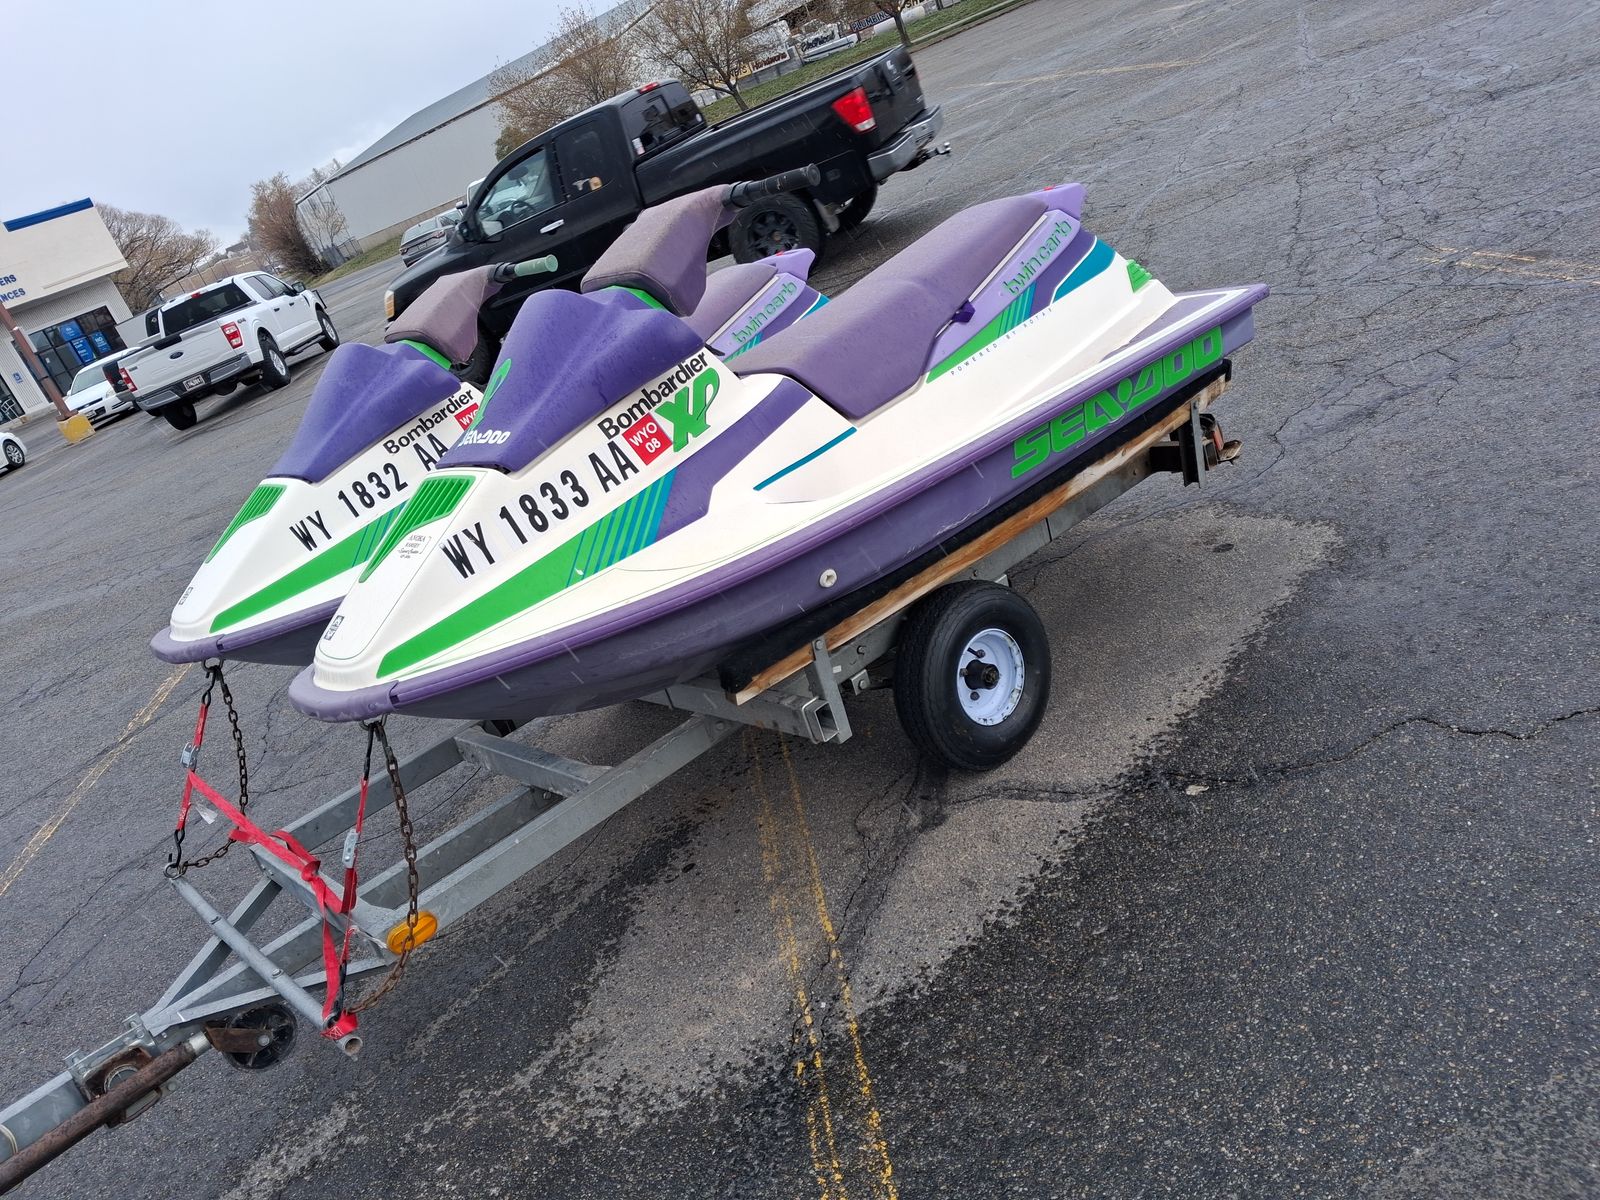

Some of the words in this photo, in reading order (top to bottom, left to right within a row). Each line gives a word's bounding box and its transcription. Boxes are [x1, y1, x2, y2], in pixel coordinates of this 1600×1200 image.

[0, 287, 26, 303] NCES
[950, 342, 998, 376] POWERED
[382, 388, 474, 455] Bombardier
[596, 351, 709, 441] Bombardier
[654, 366, 720, 453] XP
[628, 421, 659, 448] WYO
[645, 437, 662, 454] 08
[289, 509, 332, 552] WY
[337, 462, 409, 518] 1832
[412, 432, 450, 472] AA
[440, 521, 496, 580] WY
[498, 469, 590, 545] 1833
[587, 439, 641, 494] AA
